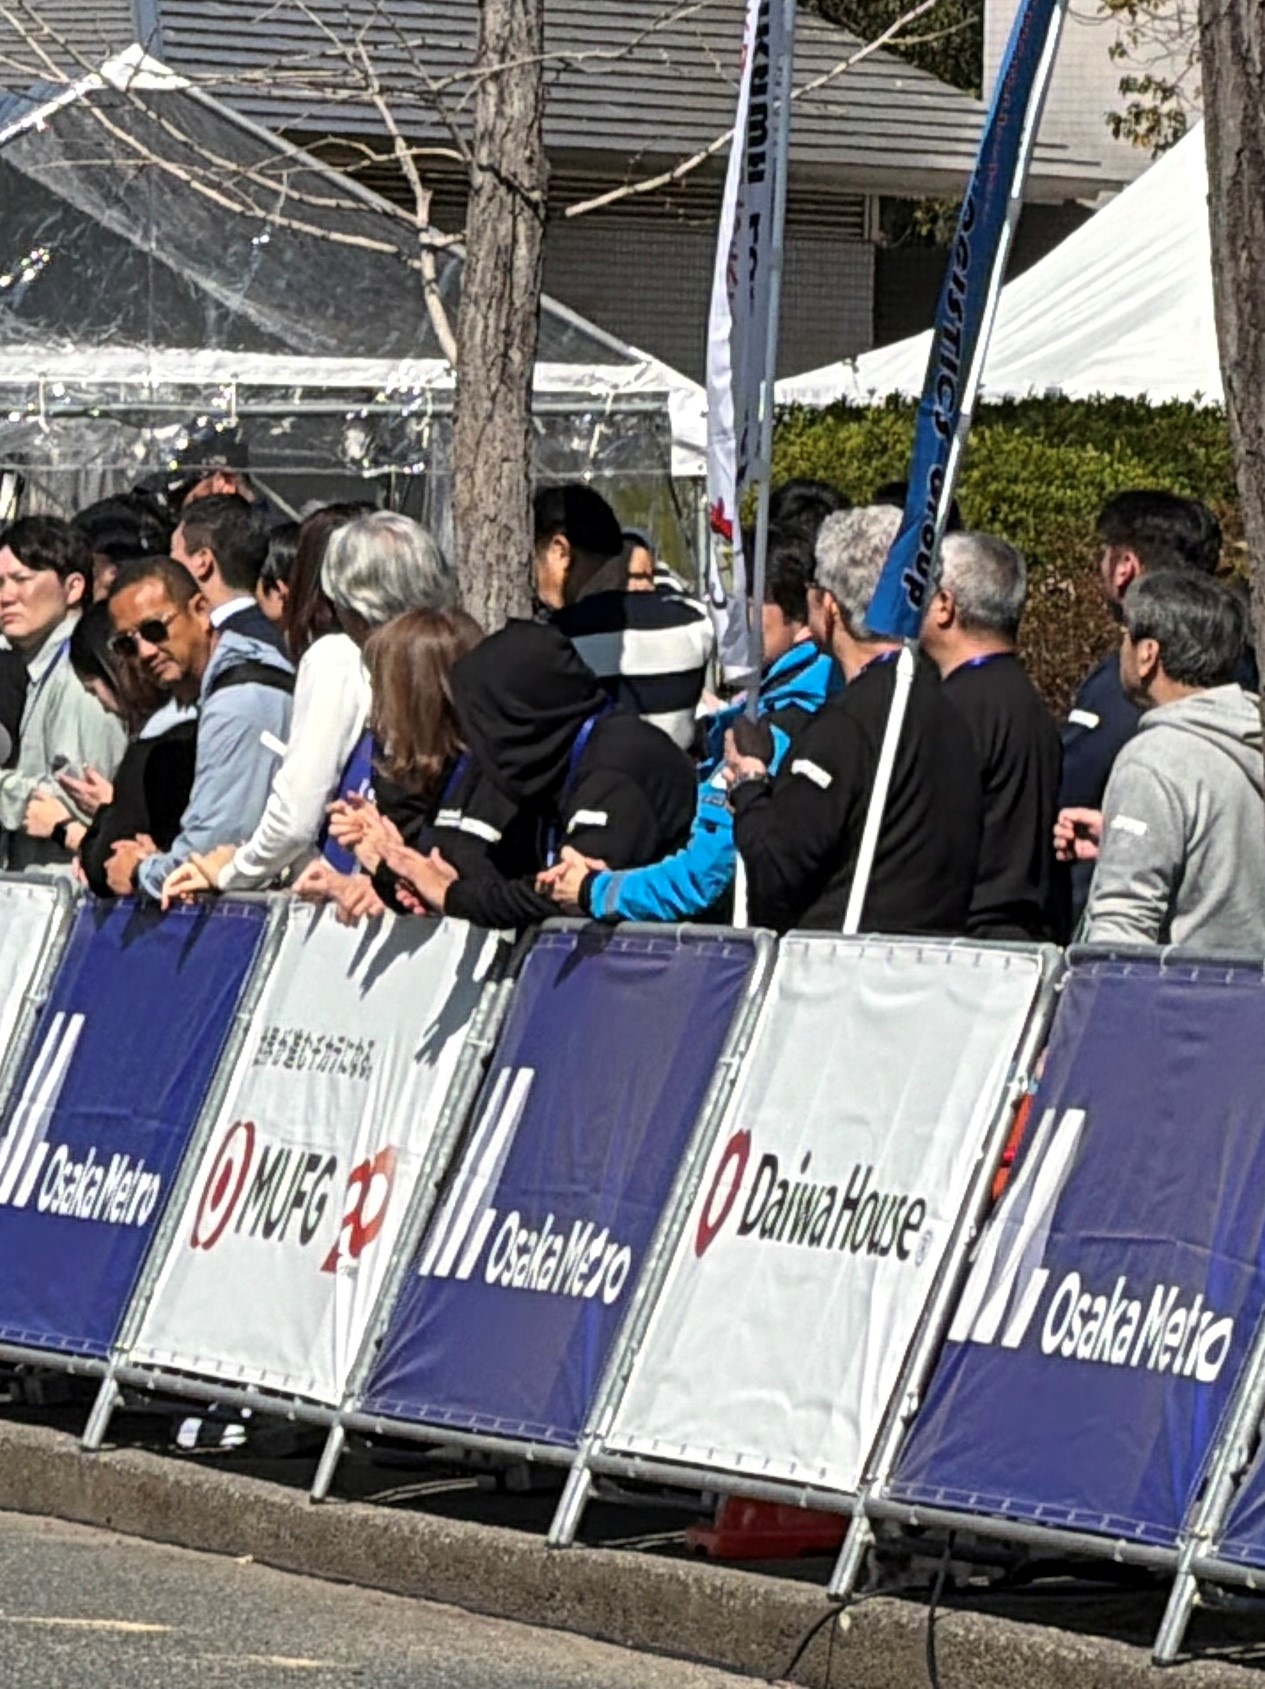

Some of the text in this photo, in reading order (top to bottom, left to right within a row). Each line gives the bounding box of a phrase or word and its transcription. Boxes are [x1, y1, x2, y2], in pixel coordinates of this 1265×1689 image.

[38, 1144, 162, 1227] Osaka Metro
[235, 1144, 338, 1247] MUFG
[737, 1151, 927, 1261] Daiwa House
[484, 1211, 632, 1304] Osaka Metro
[1042, 1271, 1235, 1383] Osaka Metro
